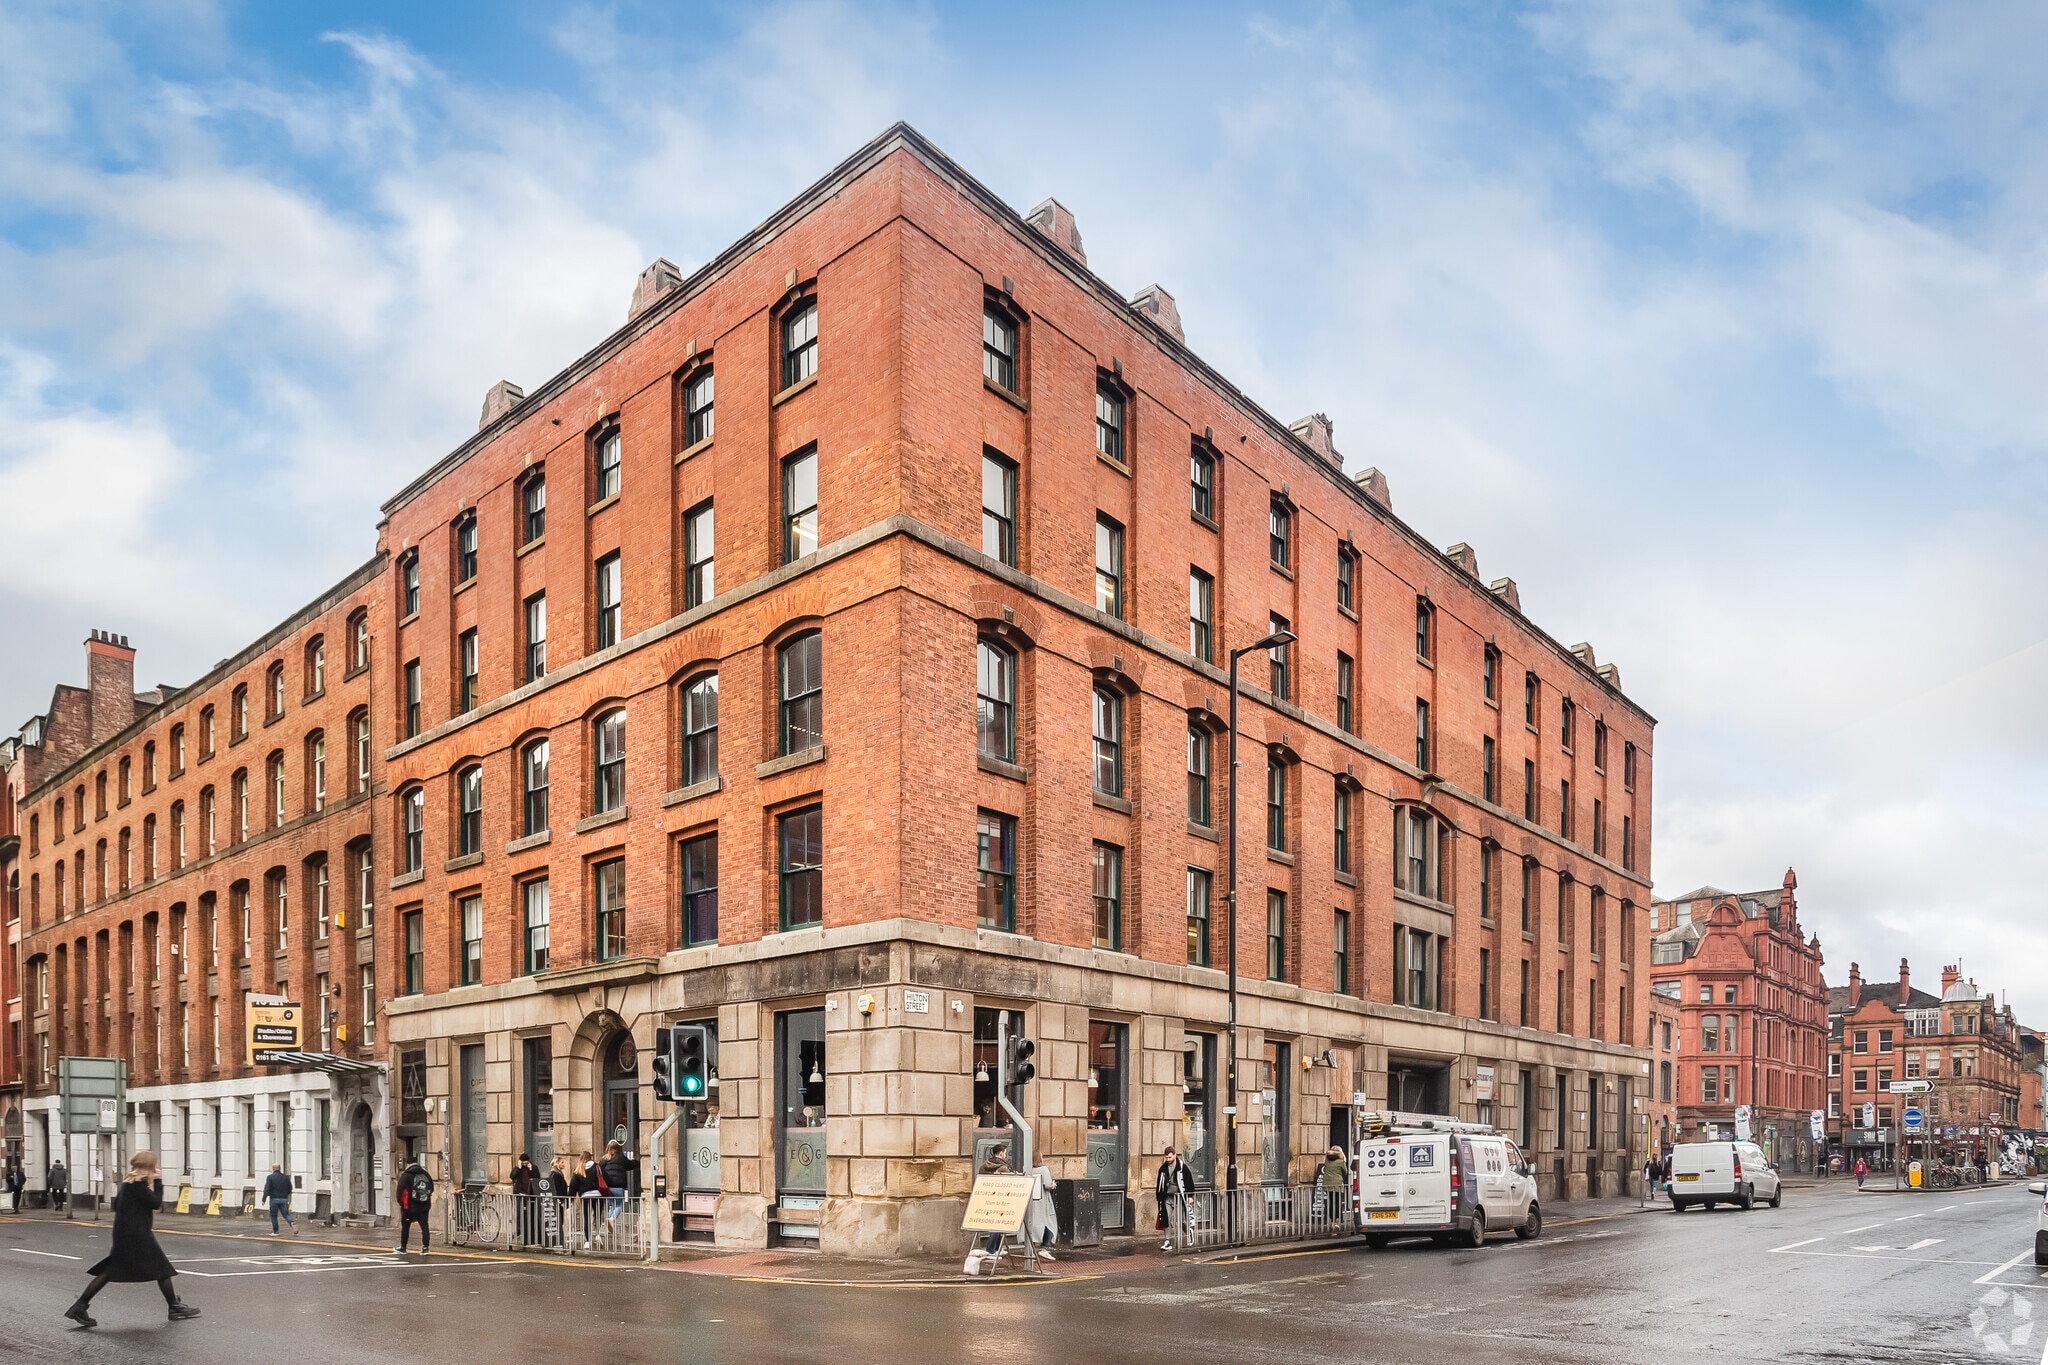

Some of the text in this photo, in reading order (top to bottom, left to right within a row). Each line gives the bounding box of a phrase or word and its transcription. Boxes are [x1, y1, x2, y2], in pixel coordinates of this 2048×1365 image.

[906, 994, 928, 1002] HILTON
[906, 1002, 925, 1010] STREET
[692, 1152, 697, 1161] E
[713, 1152, 718, 1161] G
[791, 1150, 796, 1159] E
[816, 1149, 821, 1159] G
